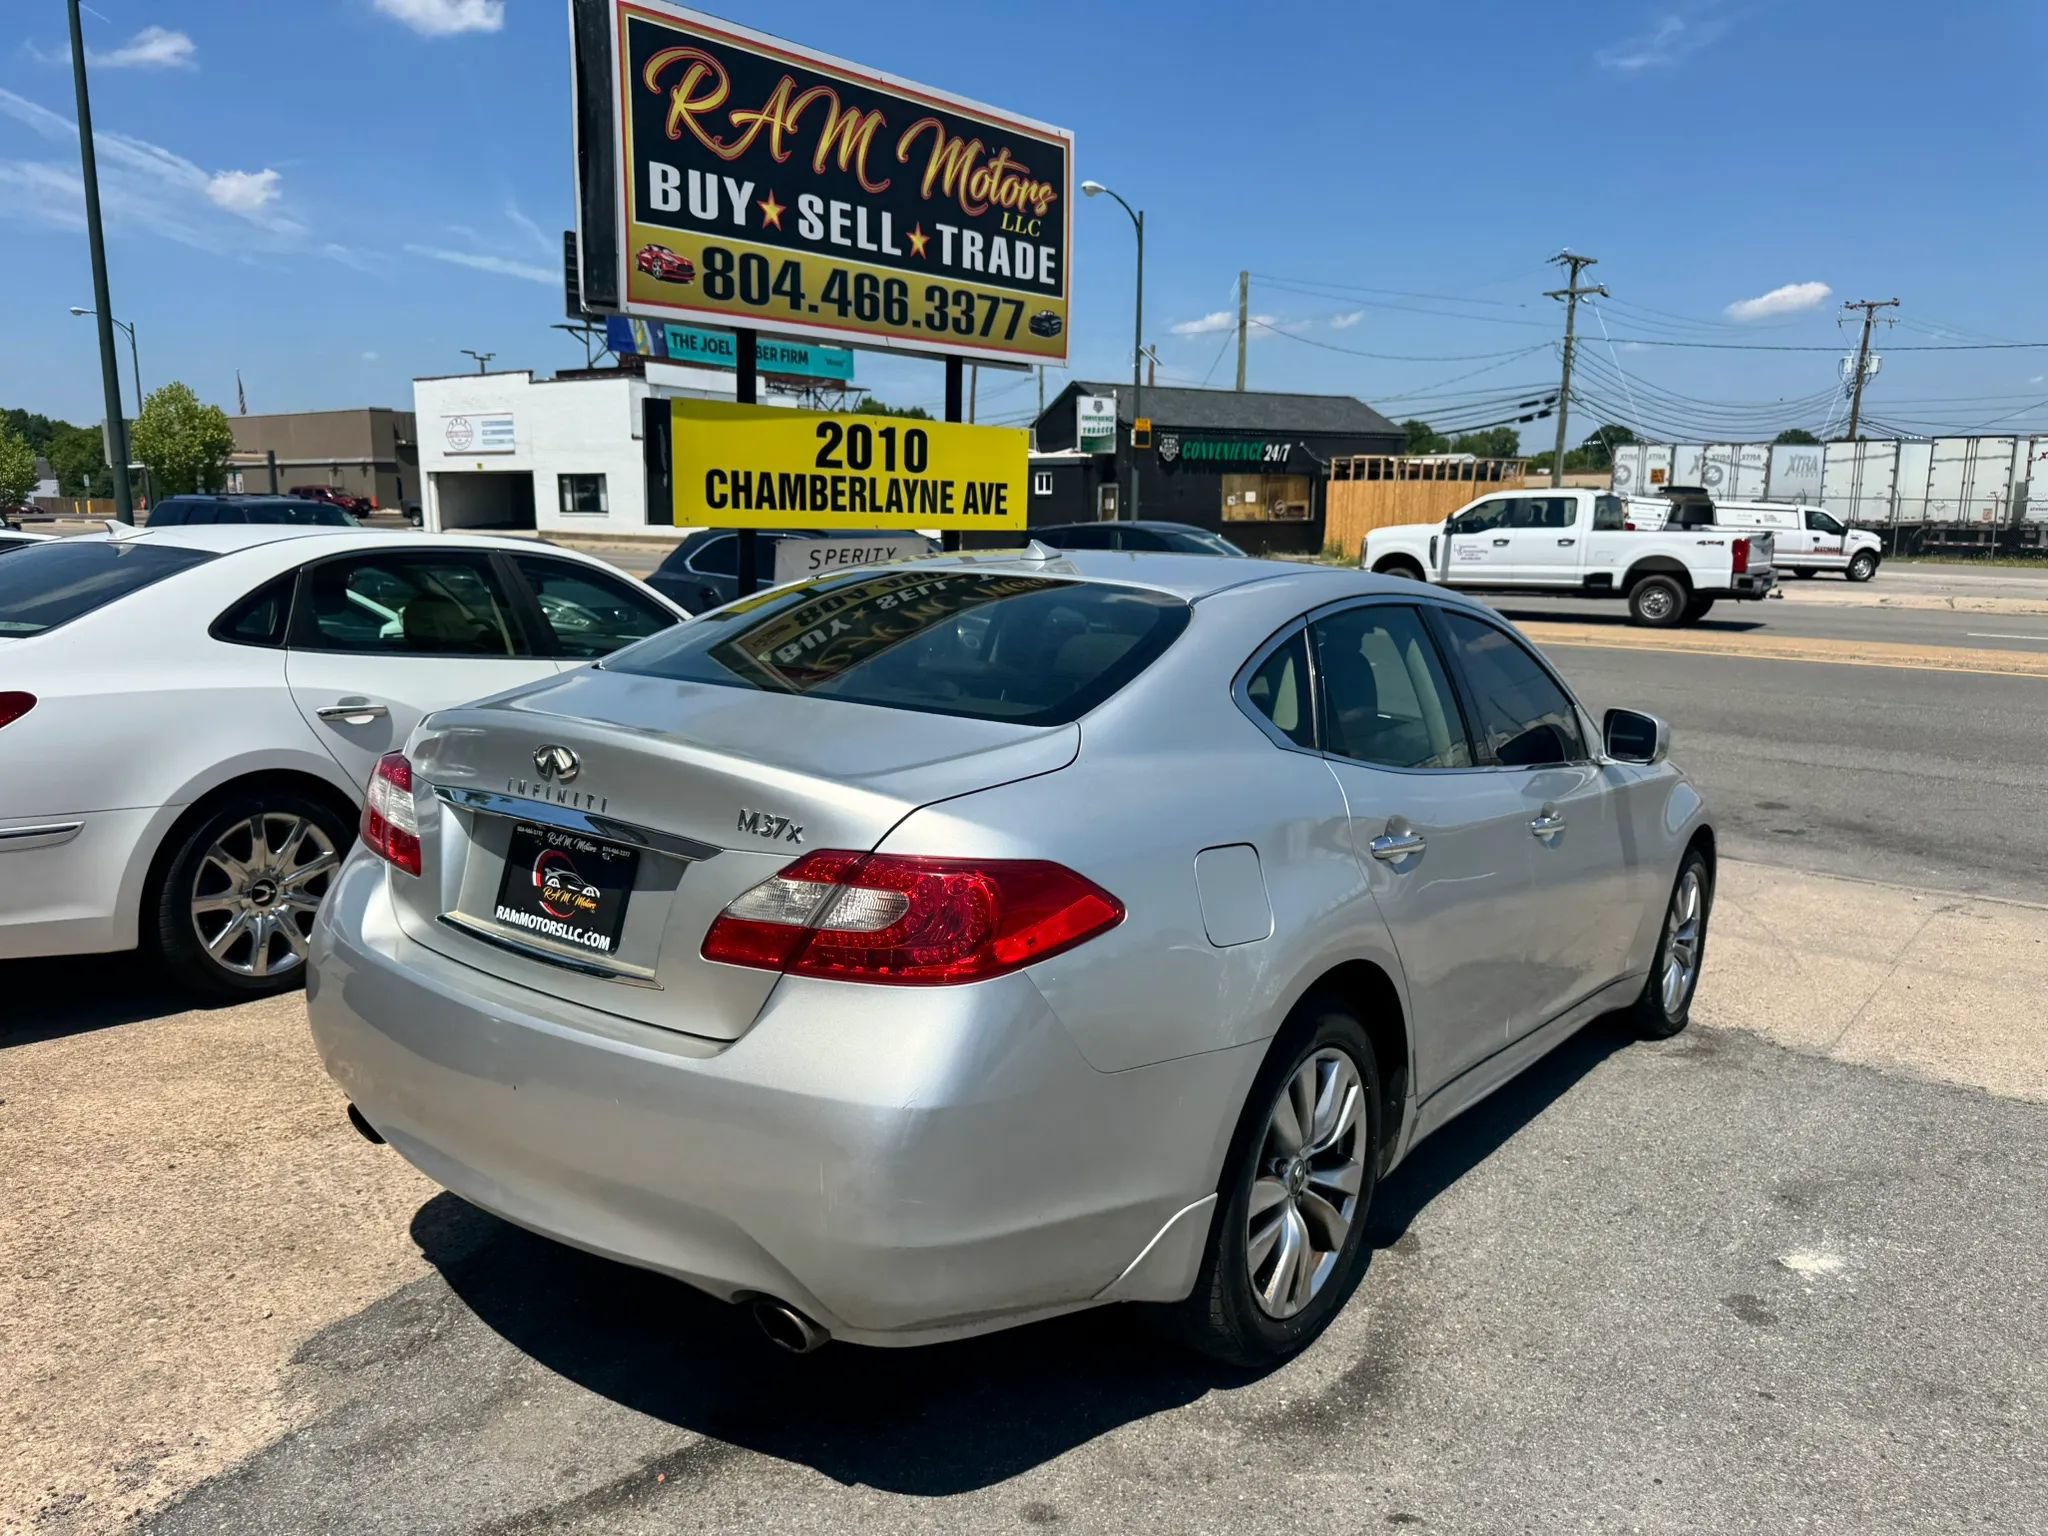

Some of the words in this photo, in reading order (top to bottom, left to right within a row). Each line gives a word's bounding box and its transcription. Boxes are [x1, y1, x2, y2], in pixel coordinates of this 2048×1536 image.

[643, 46, 890, 194] RAM
[896, 117, 1057, 216] Motors
[649, 160, 756, 226] BUY
[798, 193, 902, 257] SELL
[935, 223, 1056, 286] TRADE
[1000, 212, 1041, 238] LLC
[702, 246, 1025, 341] 804.466.3377
[671, 332, 698, 351] THE
[701, 335, 733, 356] JOEL
[781, 348, 809, 366] FIRM
[815, 420, 928, 474] 2010
[1182, 441, 1264, 460] CONVENIENCE
[1263, 443, 1291, 462] 24/7
[705, 468, 955, 515] CHAMBERLAYNE
[963, 481, 1008, 516] AVE
[808, 546, 897, 569] SPERITY
[507, 777, 608, 813] INFINITI
[543, 886, 571, 905] RAM
[572, 893, 598, 911] Motors
